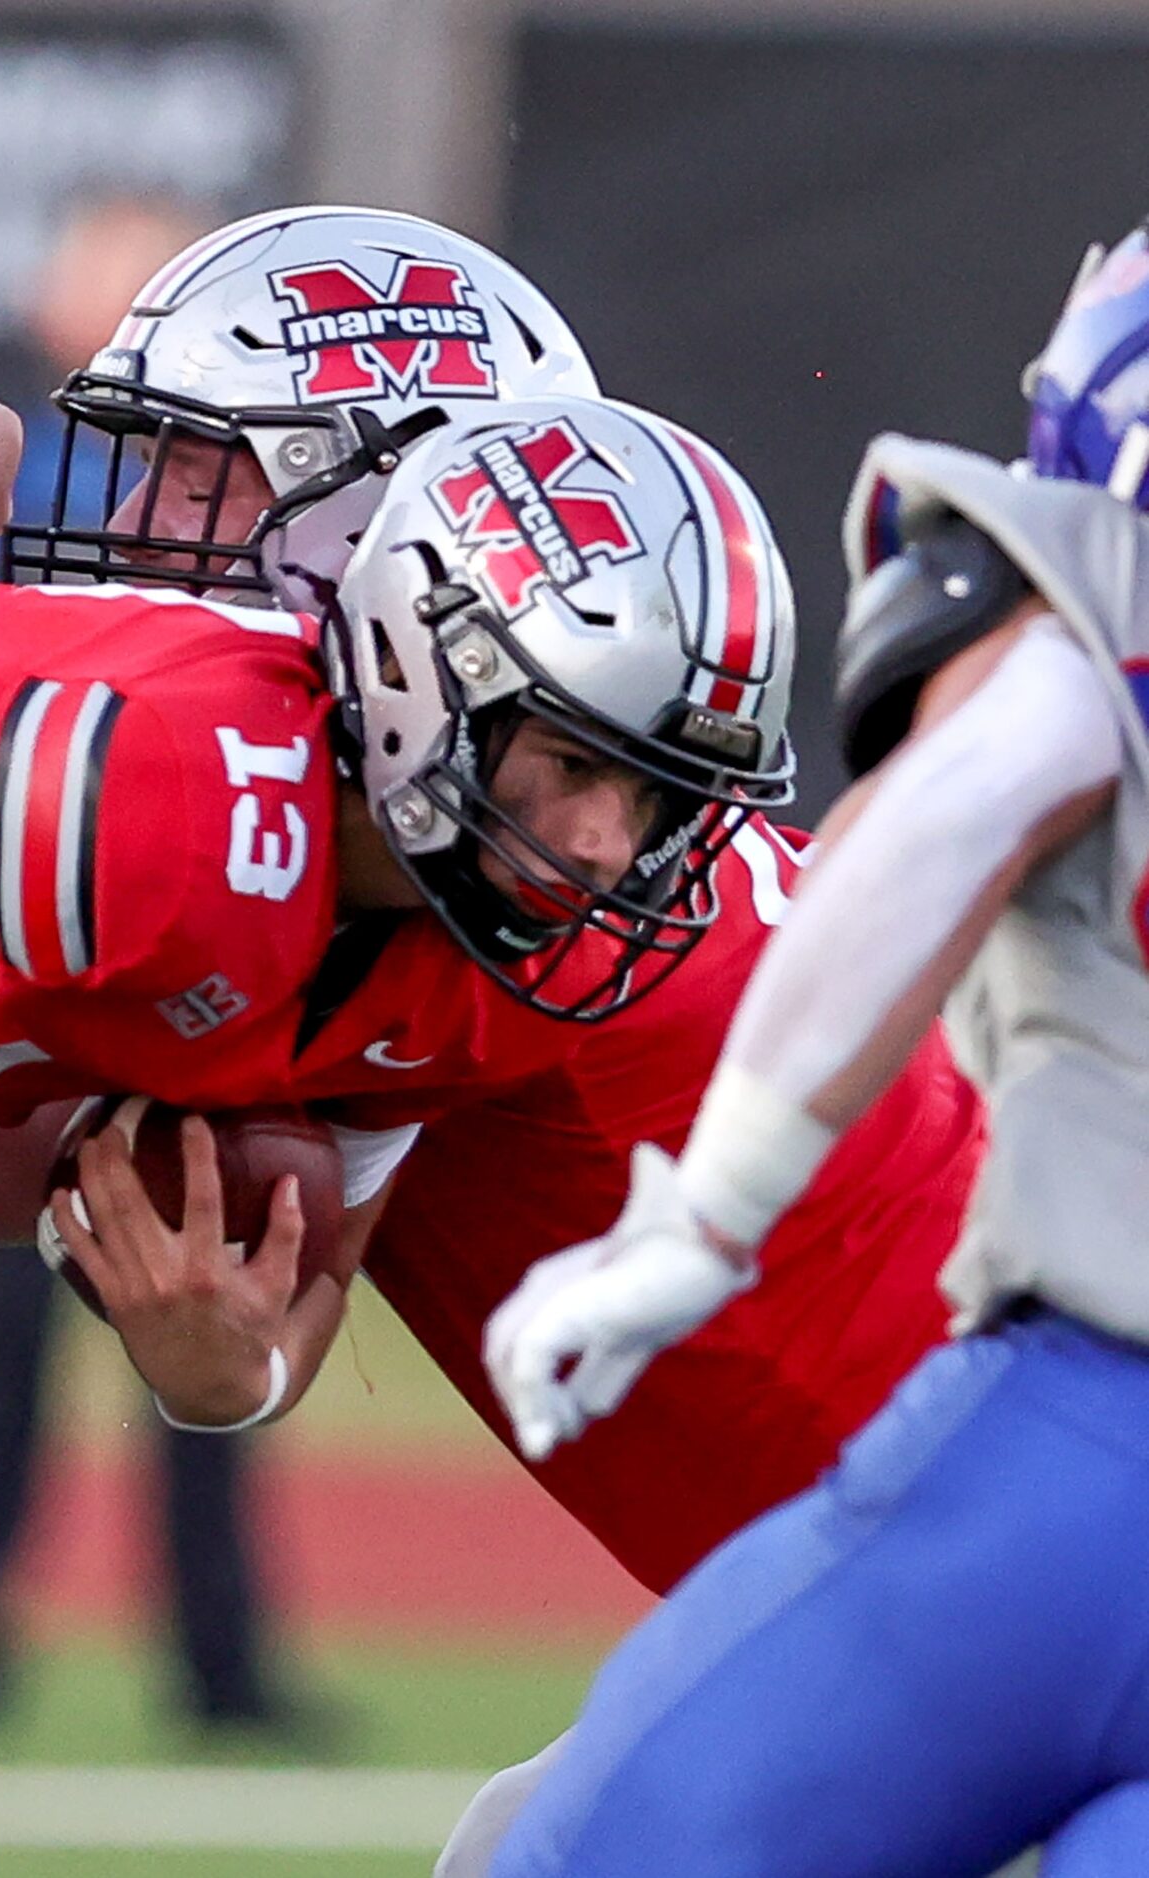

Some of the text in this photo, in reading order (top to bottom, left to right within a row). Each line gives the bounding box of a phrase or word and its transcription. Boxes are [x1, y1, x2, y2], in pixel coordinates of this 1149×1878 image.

[287, 306, 485, 347] marcus
[479, 438, 583, 584] marcus
[214, 726, 310, 901] 13
